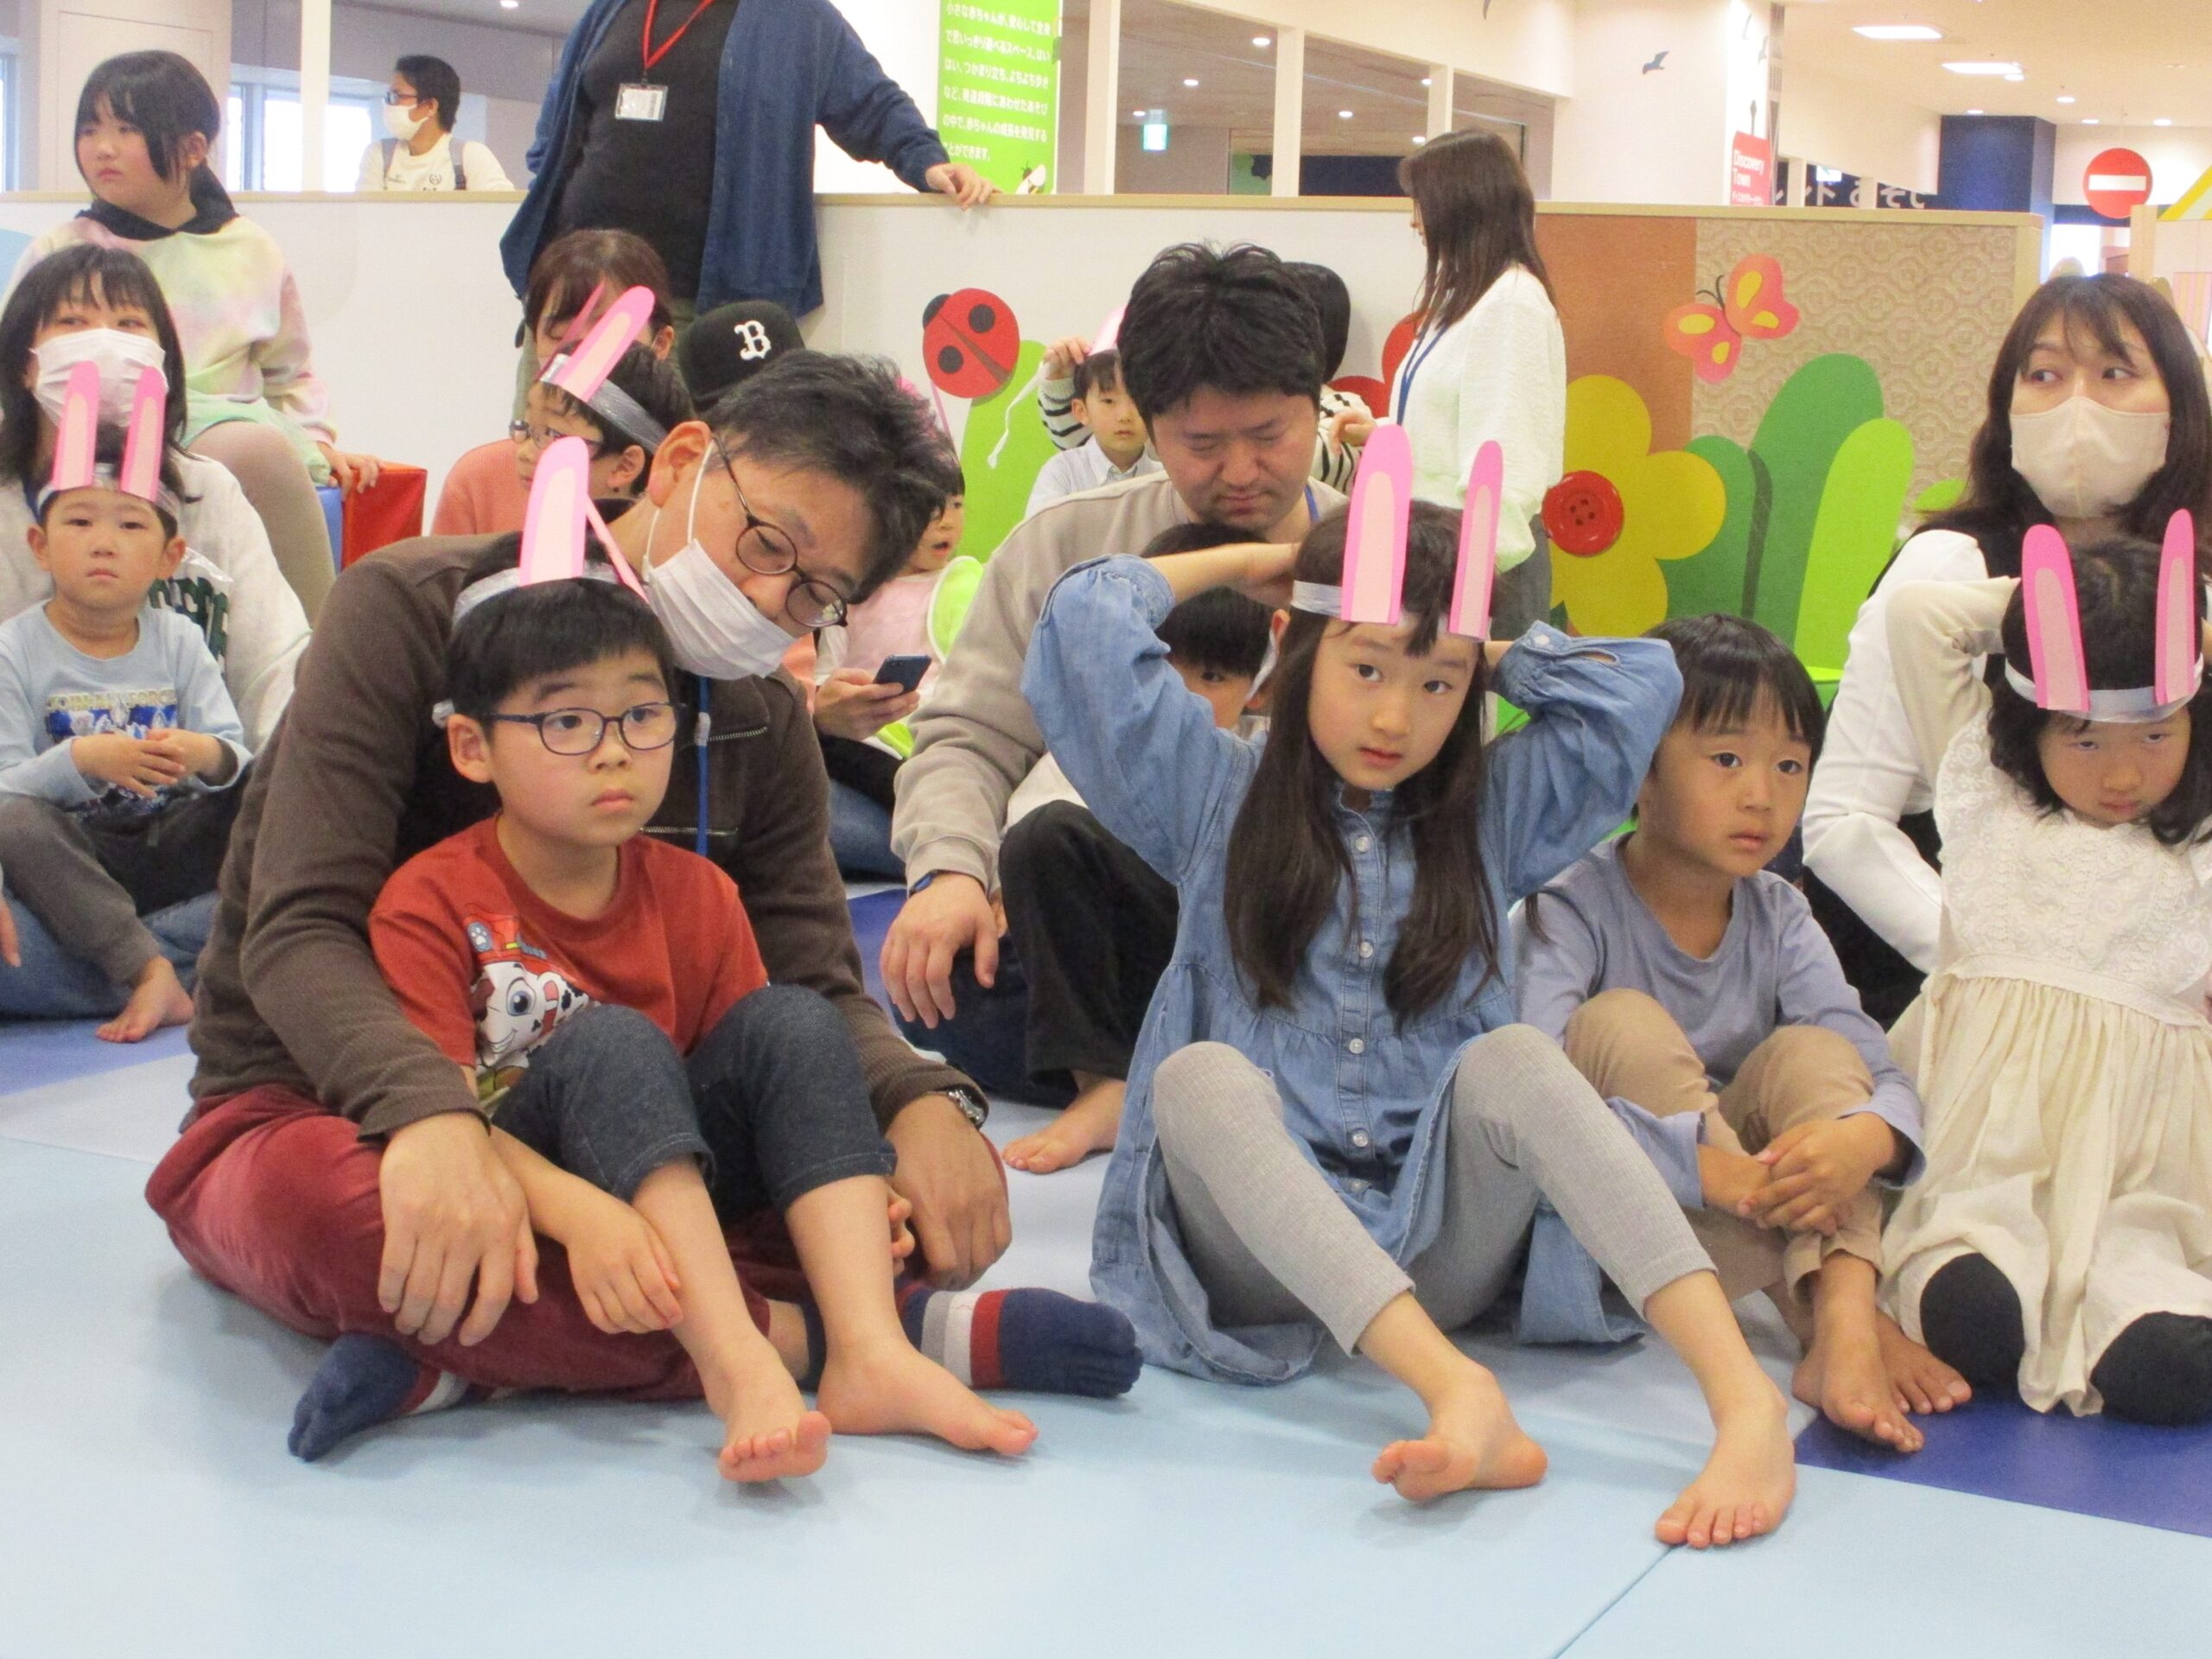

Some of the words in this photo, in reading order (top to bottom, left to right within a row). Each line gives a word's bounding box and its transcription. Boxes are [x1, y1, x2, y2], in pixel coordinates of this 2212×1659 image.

[1733, 149, 1765, 176] Discovery
[1732, 168, 1751, 188] Town
[734, 320, 772, 361] B
